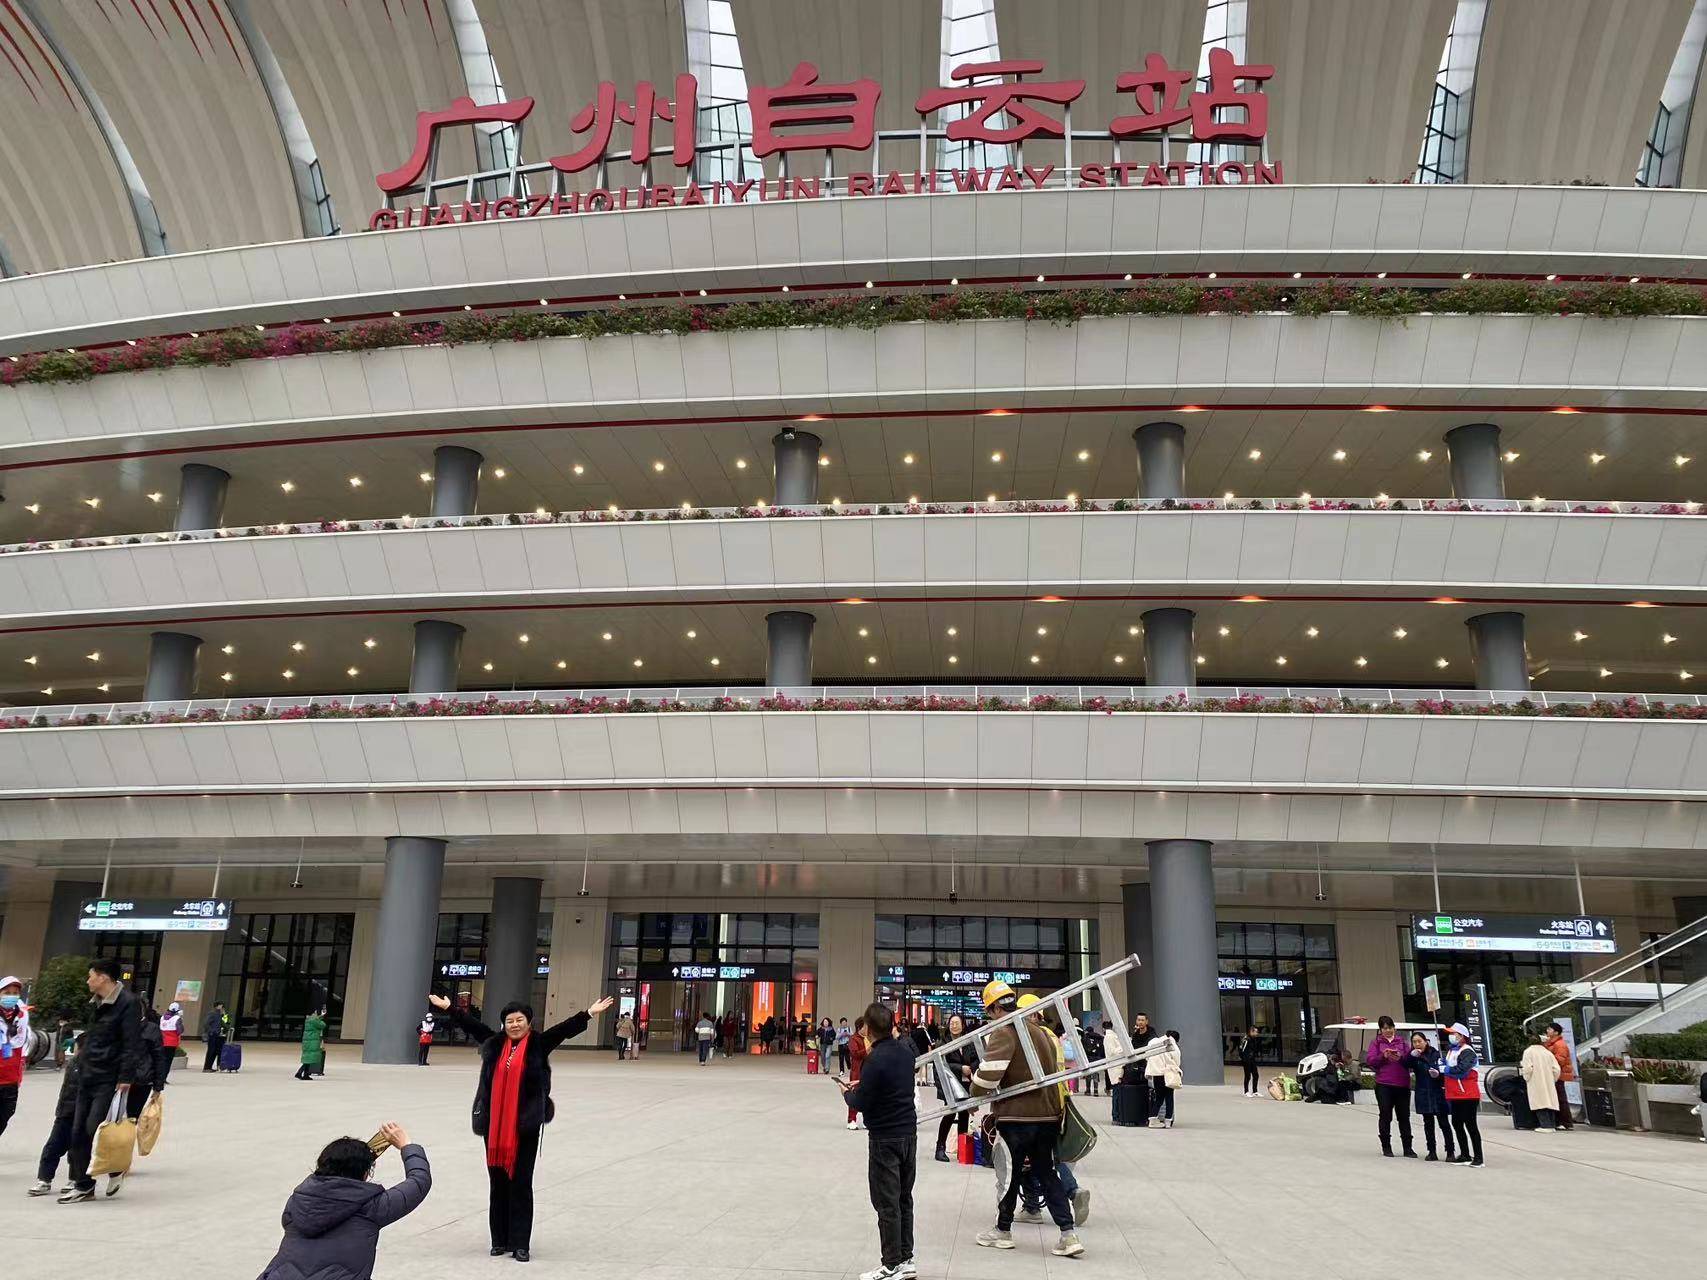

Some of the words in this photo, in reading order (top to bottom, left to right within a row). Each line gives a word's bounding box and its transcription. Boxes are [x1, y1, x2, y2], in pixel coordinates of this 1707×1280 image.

[376, 47, 1275, 191] 广州白云站
[848, 164, 1055, 196] RAILWAY
[1079, 159, 1284, 189] STATION
